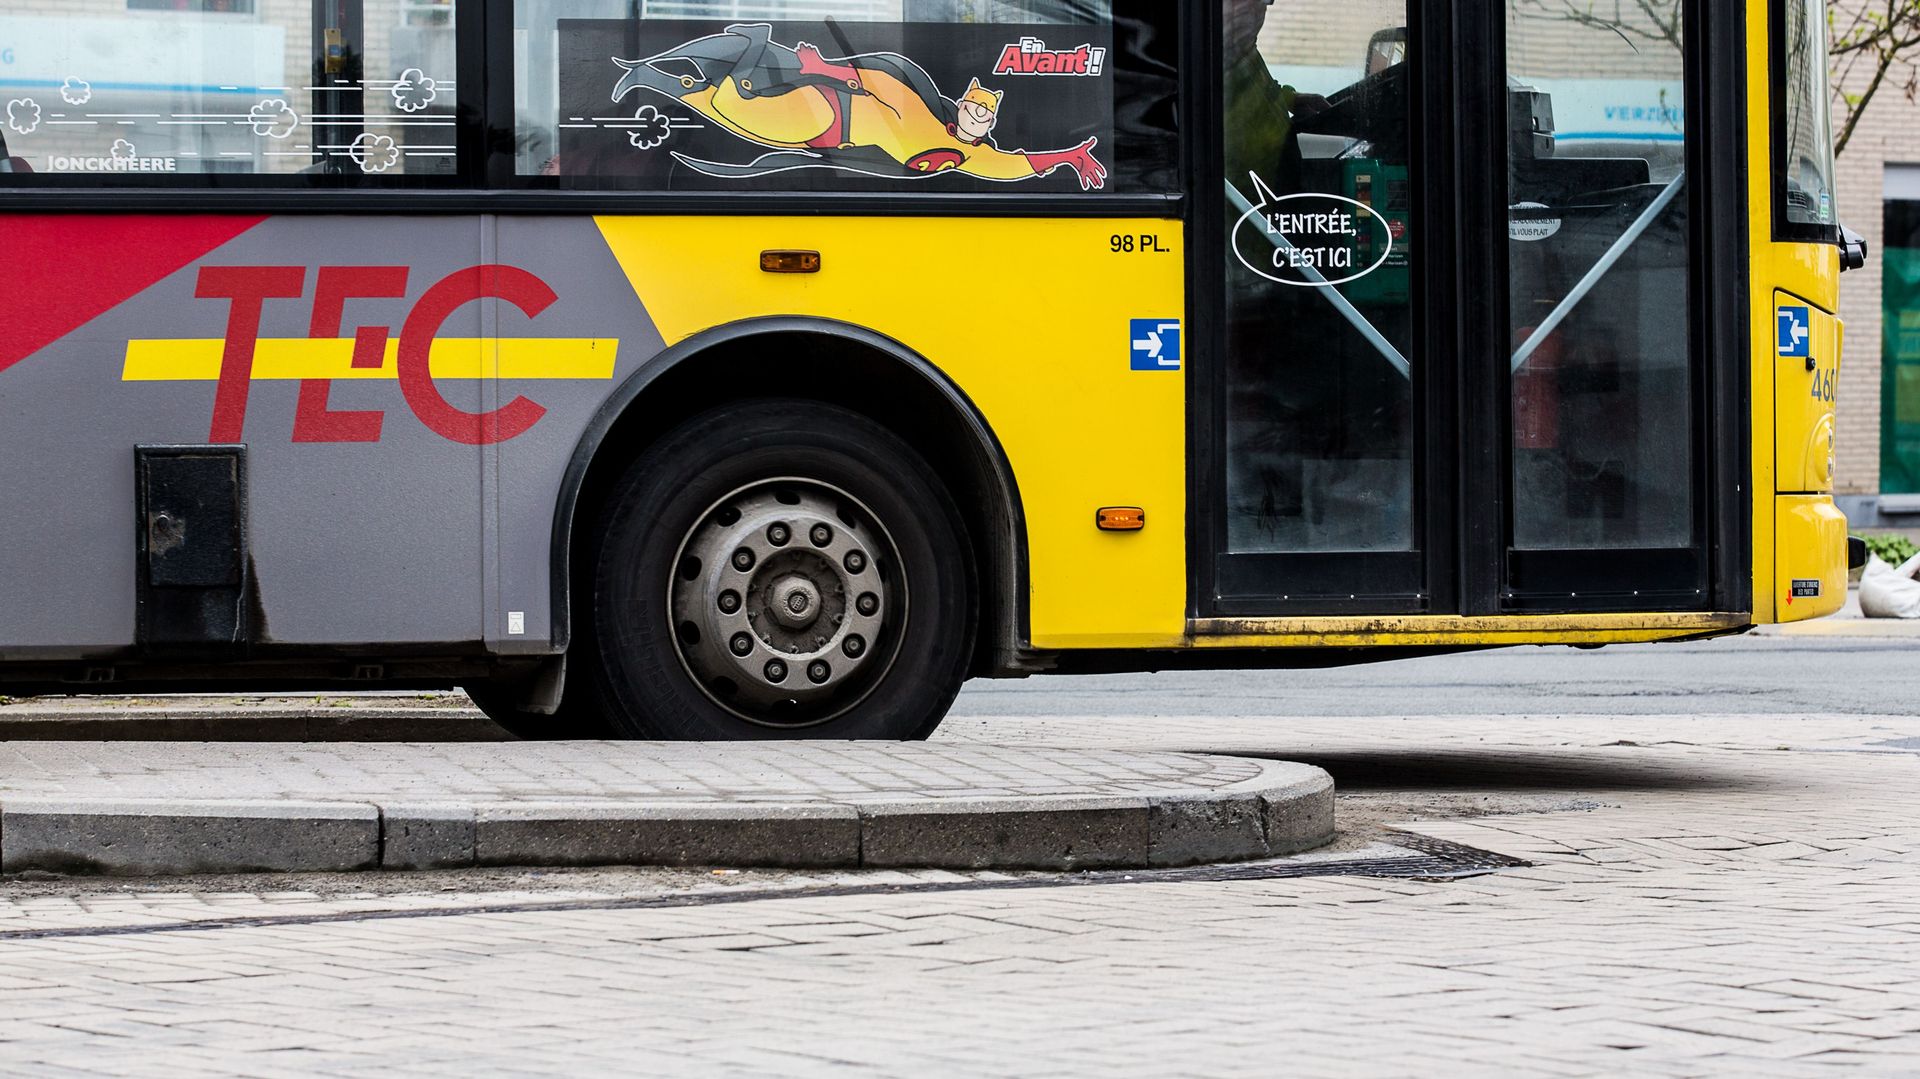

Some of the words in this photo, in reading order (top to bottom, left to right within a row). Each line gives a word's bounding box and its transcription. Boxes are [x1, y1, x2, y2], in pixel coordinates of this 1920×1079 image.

[1021, 38, 1042, 54] En
[46, 155, 176, 172] JONCKHEERE
[1266, 207, 1358, 237] L'ENTRÉE,
[1109, 234, 1134, 252] 98
[1139, 234, 1171, 252] PL.
[1272, 247, 1323, 268] C'EST
[1328, 247, 1352, 268] ICI
[194, 264, 559, 445] TEC
